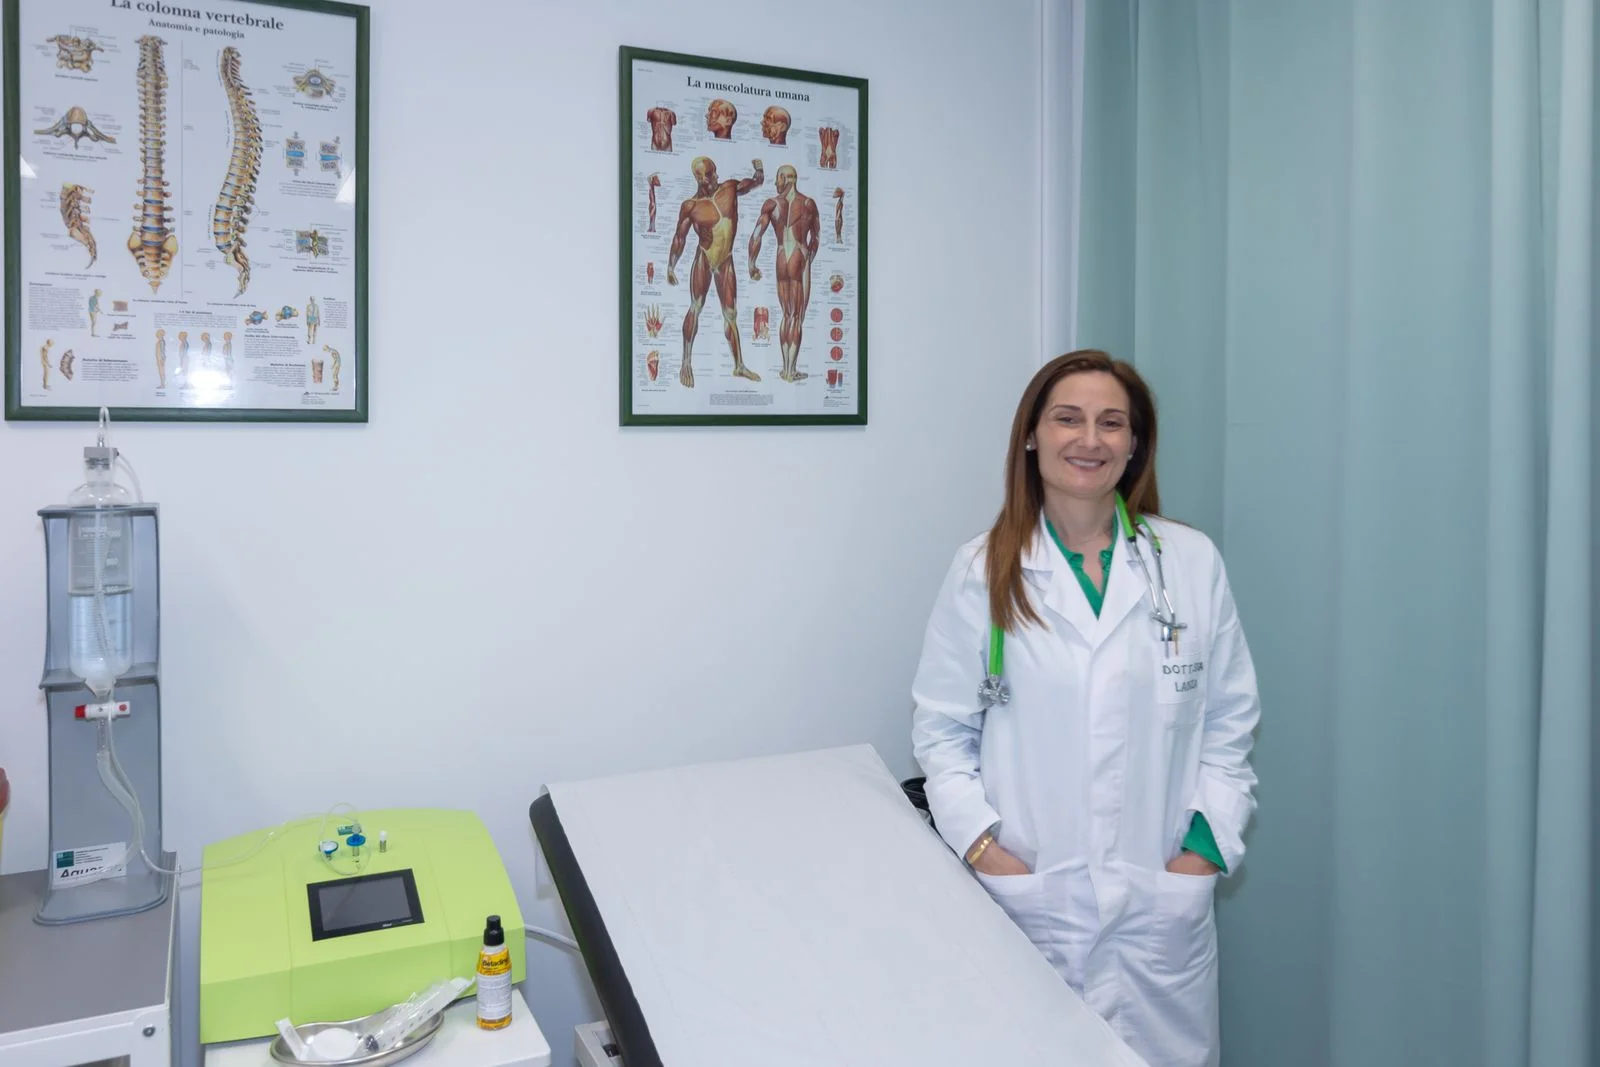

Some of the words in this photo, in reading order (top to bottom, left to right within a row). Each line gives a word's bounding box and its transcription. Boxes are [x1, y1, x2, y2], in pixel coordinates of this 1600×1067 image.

[111, 0, 132, 9] La
[137, 0, 200, 19] colonna
[205, 11, 284, 31] vertebrale
[148, 19, 193, 33] Anatomia
[203, 27, 245, 40] patologia
[687, 76, 701, 88] La
[705, 81, 772, 98] muscolatura
[775, 90, 810, 102] umana
